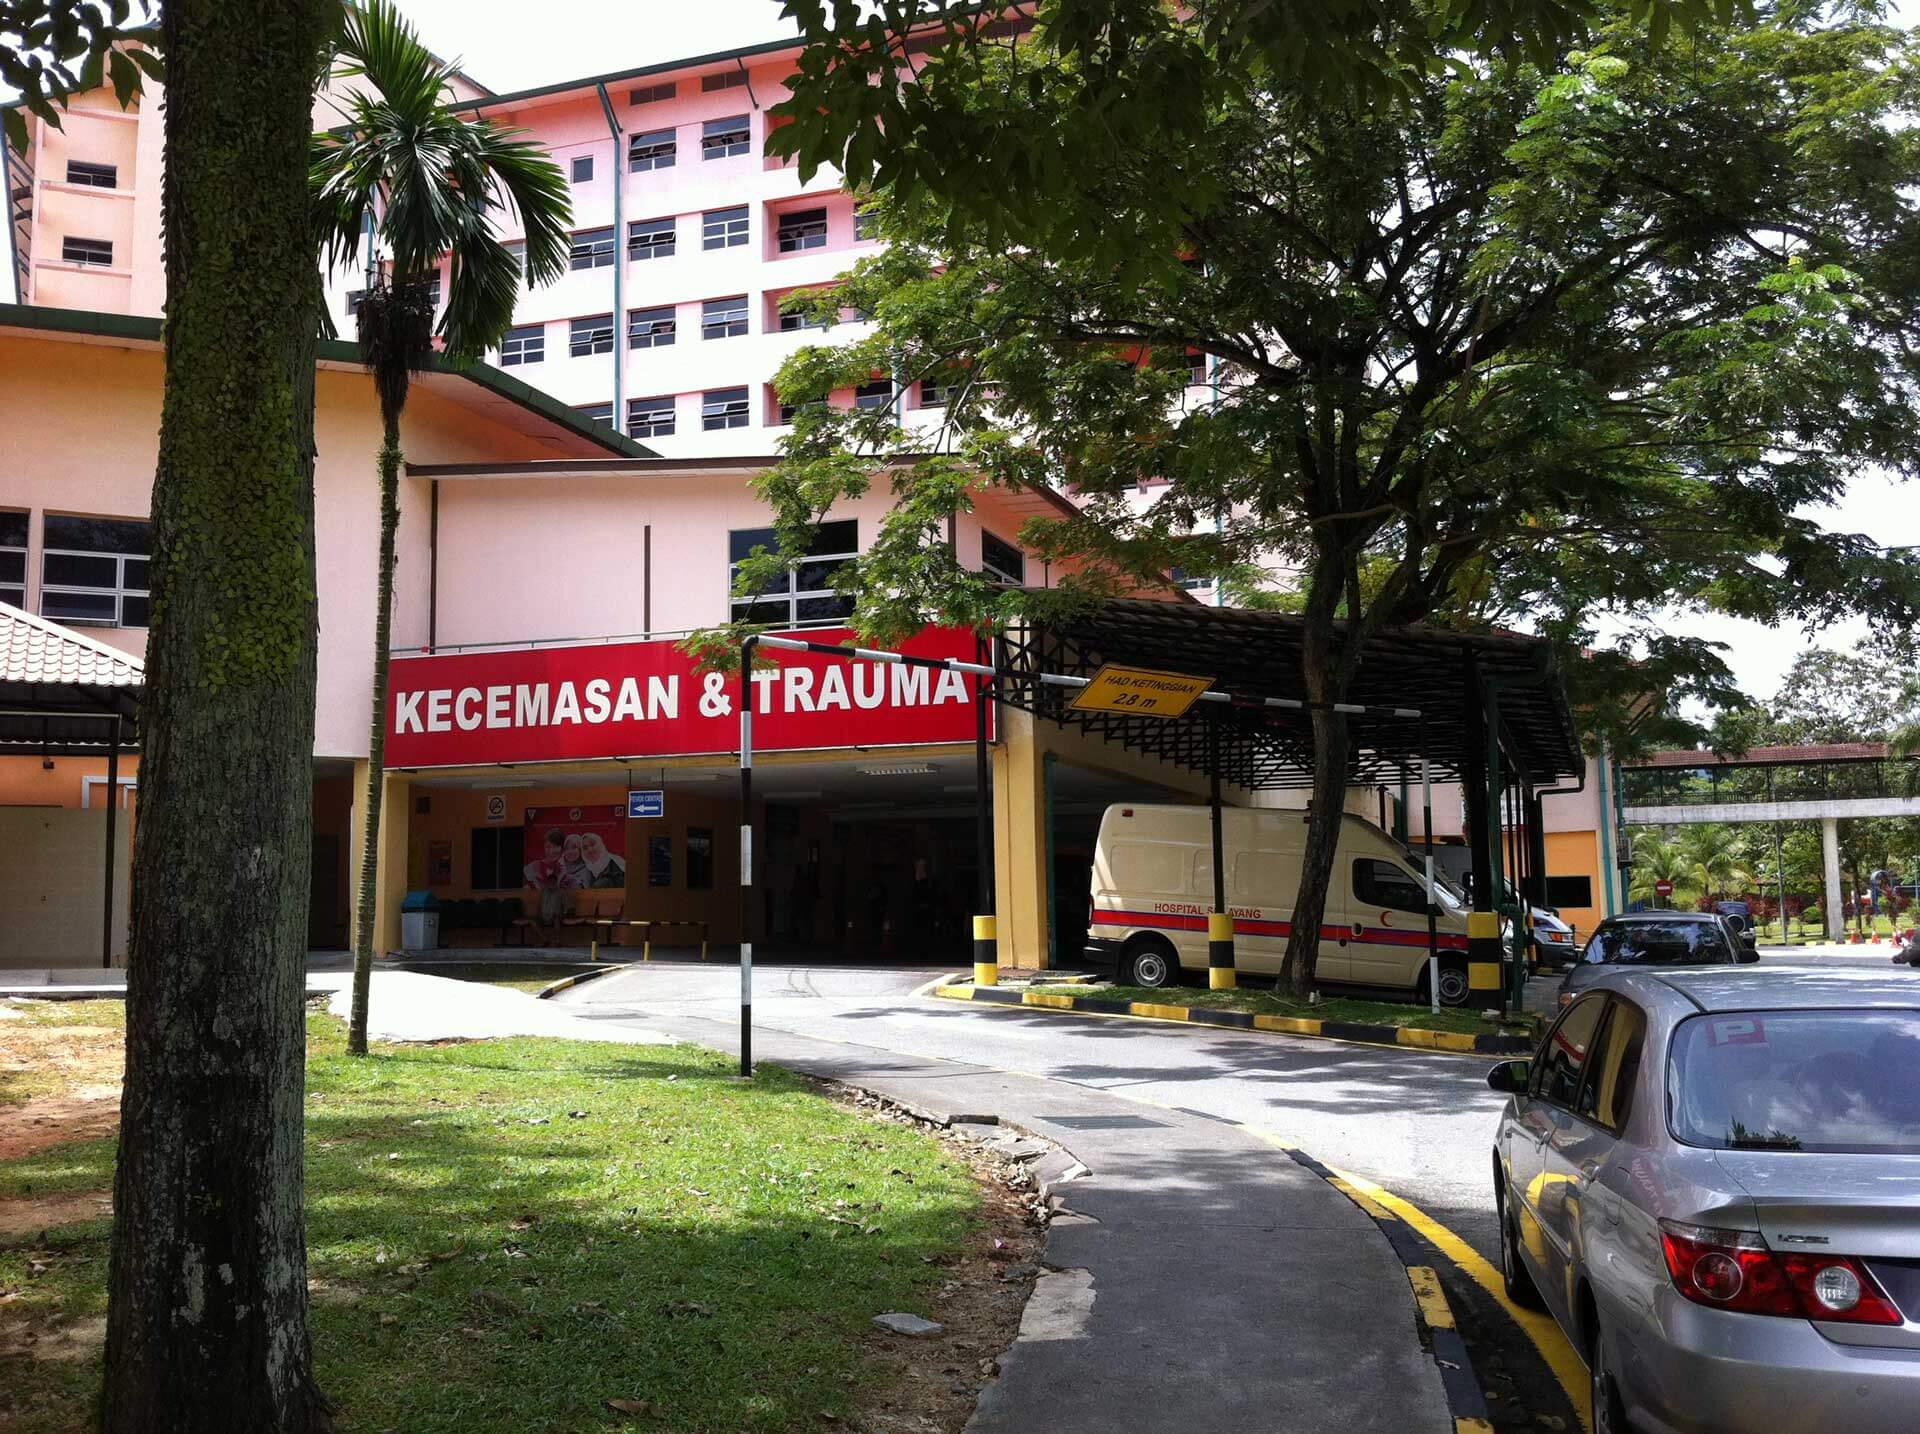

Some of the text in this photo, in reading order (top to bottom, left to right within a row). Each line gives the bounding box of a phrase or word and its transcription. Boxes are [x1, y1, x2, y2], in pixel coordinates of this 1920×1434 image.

[1104, 675, 1198, 694] HAD KETINGGIAN
[394, 657, 970, 734] KECEMASAN & TRAUMA
[1112, 693, 1157, 708] 2.8 m
[1154, 903, 1262, 919] HOSPITAL SAYANG
